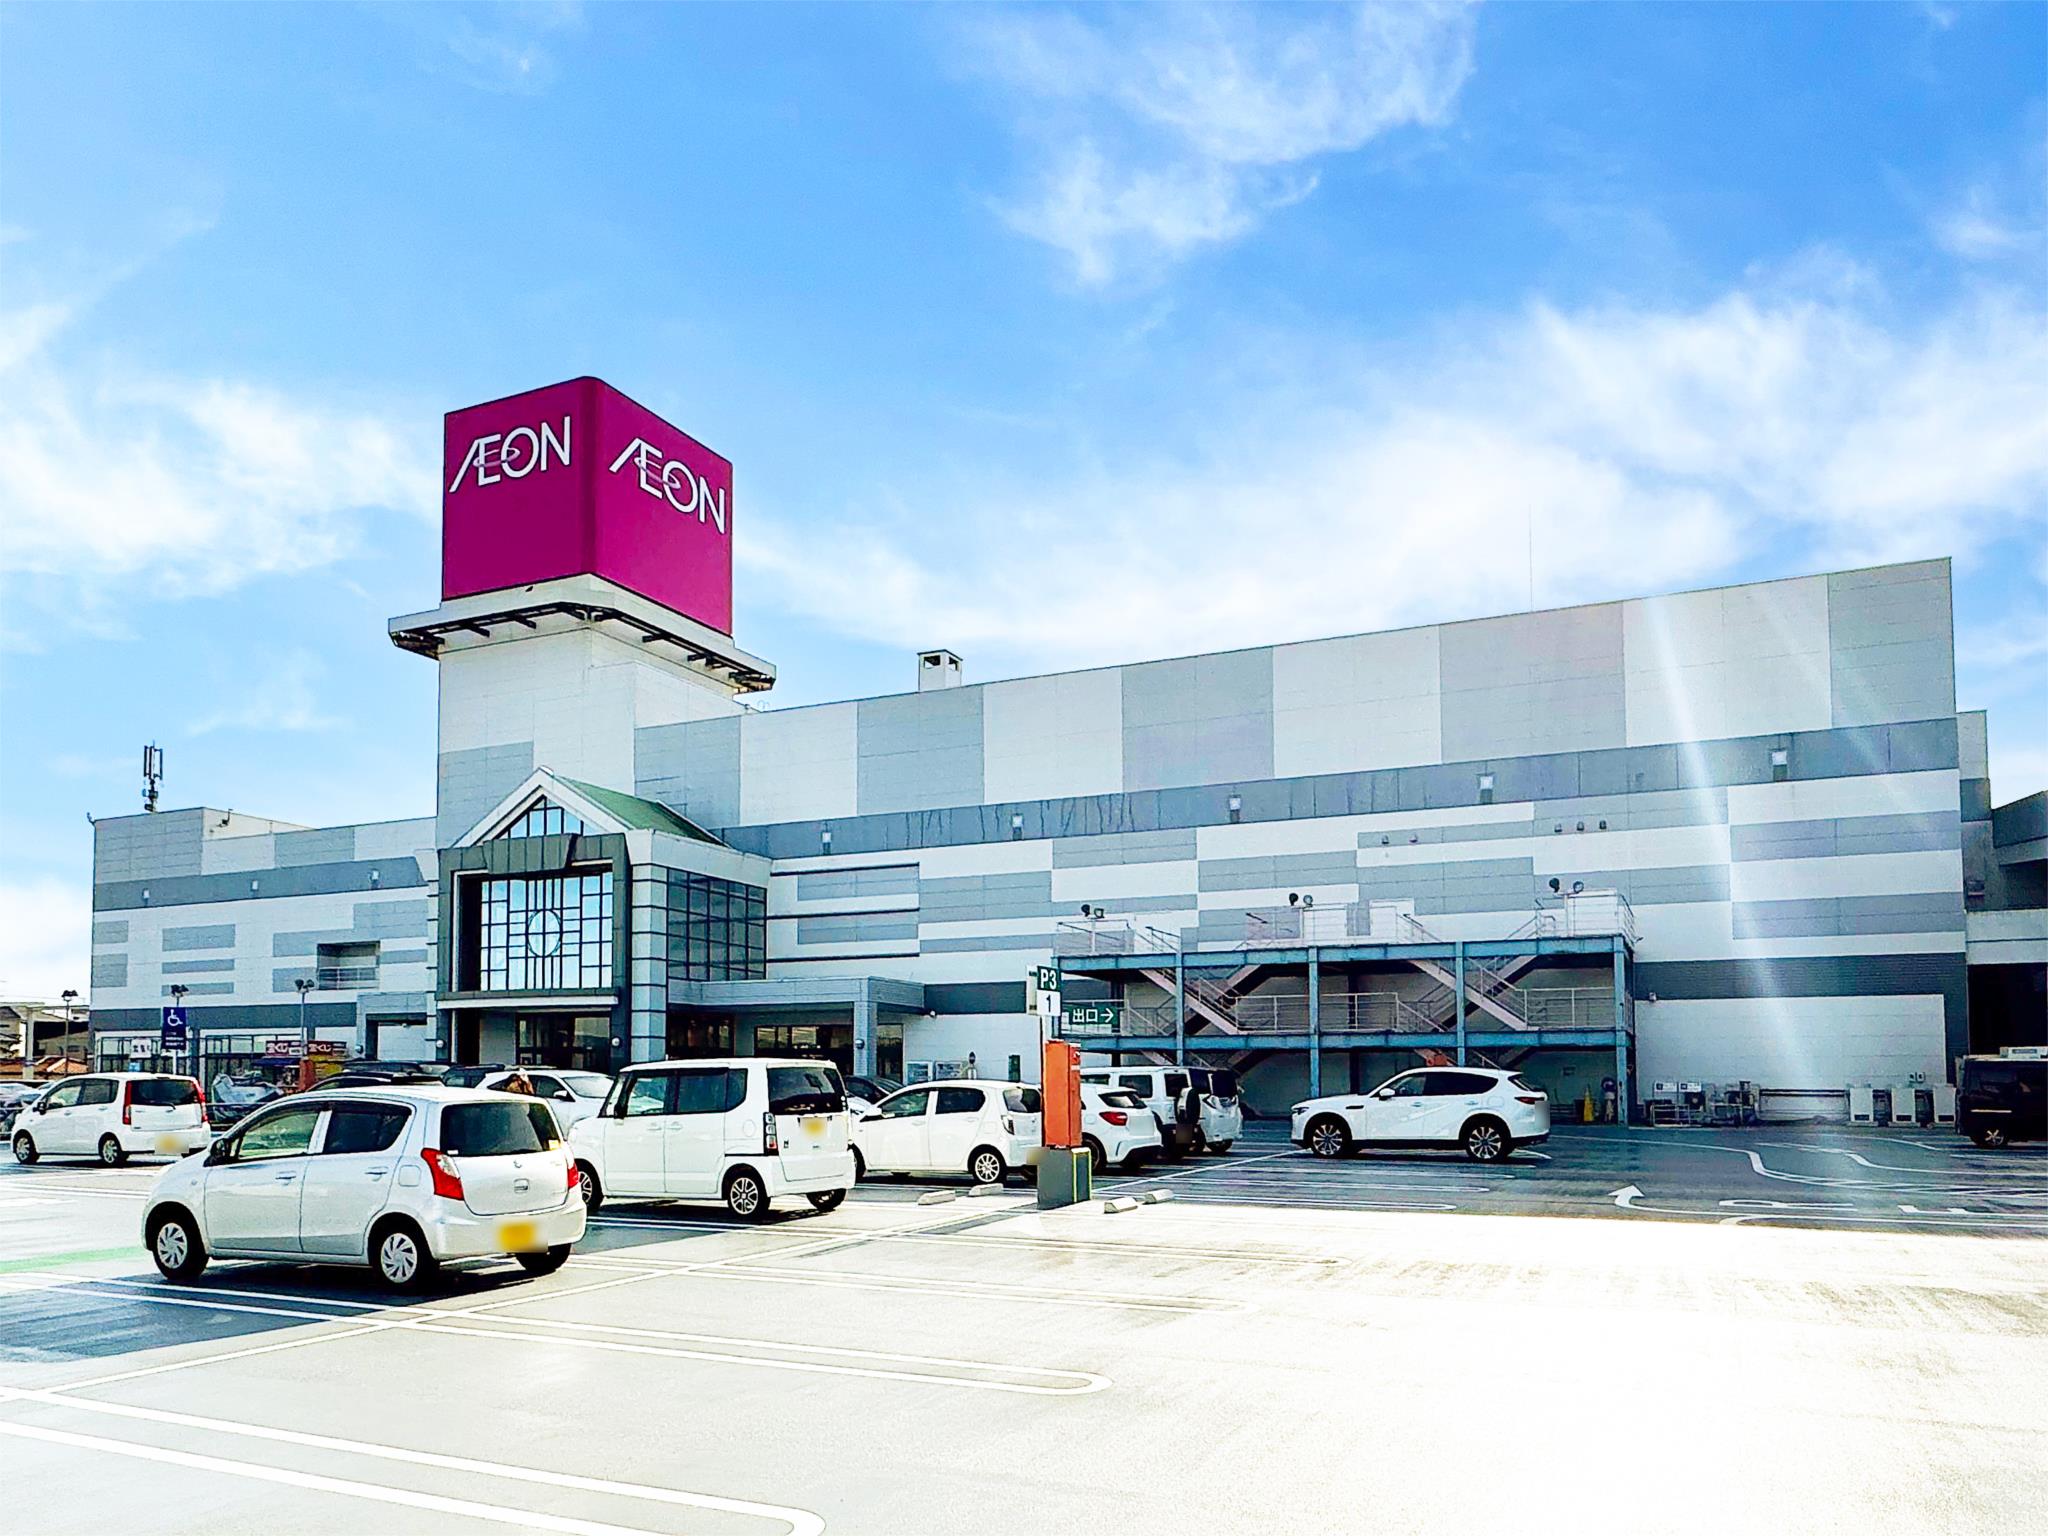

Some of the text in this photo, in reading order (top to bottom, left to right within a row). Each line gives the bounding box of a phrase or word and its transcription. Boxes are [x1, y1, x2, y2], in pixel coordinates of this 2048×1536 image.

[1040, 968, 1057, 990] P3
[1046, 994, 1052, 1013] 1
[1072, 1008, 1098, 1023] 出口
